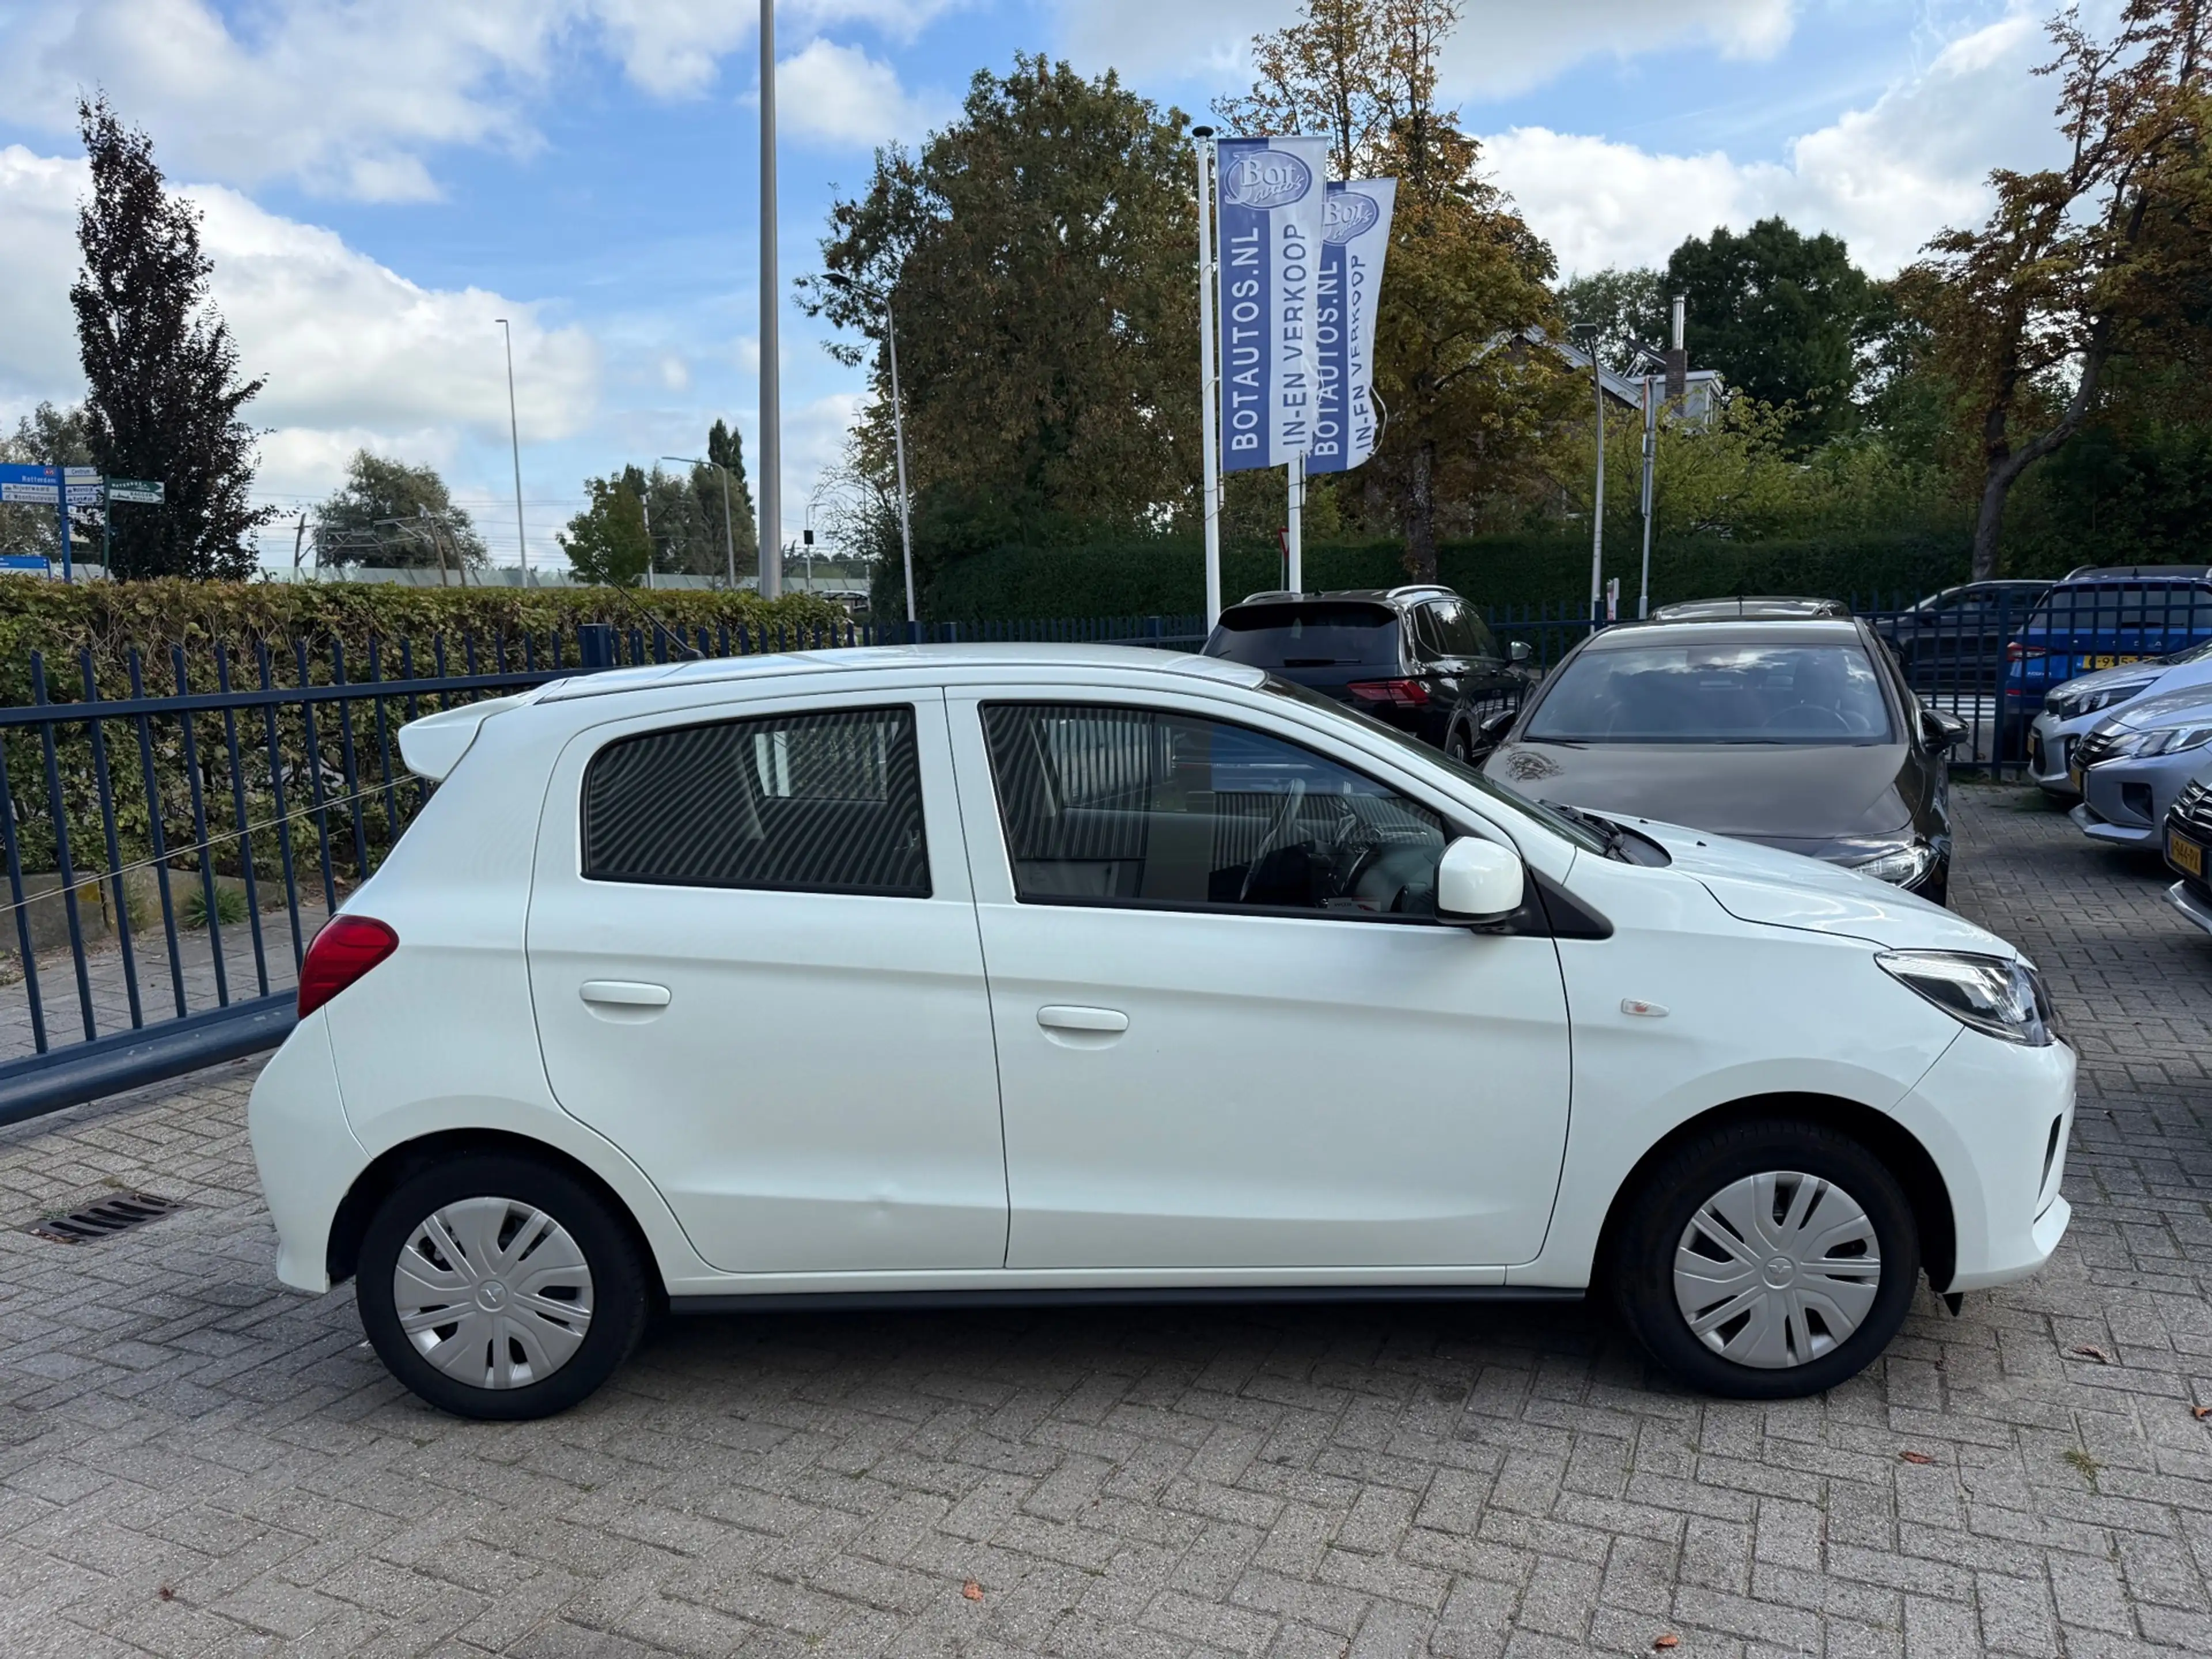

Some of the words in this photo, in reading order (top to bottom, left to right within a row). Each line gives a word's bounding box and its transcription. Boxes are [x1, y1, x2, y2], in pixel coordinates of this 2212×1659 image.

[1239, 159, 1296, 188] Bot
[1320, 200, 1366, 226] Bot
[1231, 228, 1260, 450] BOTAUTOS.NL
[1283, 224, 1307, 361] VERKOOP
[1350, 254, 1366, 377] VERKOOP
[1315, 261, 1339, 456] BOTAUTOS.NL
[1283, 373, 1307, 446] IN-EN
[22, 475, 56, 484] Rotterdam
